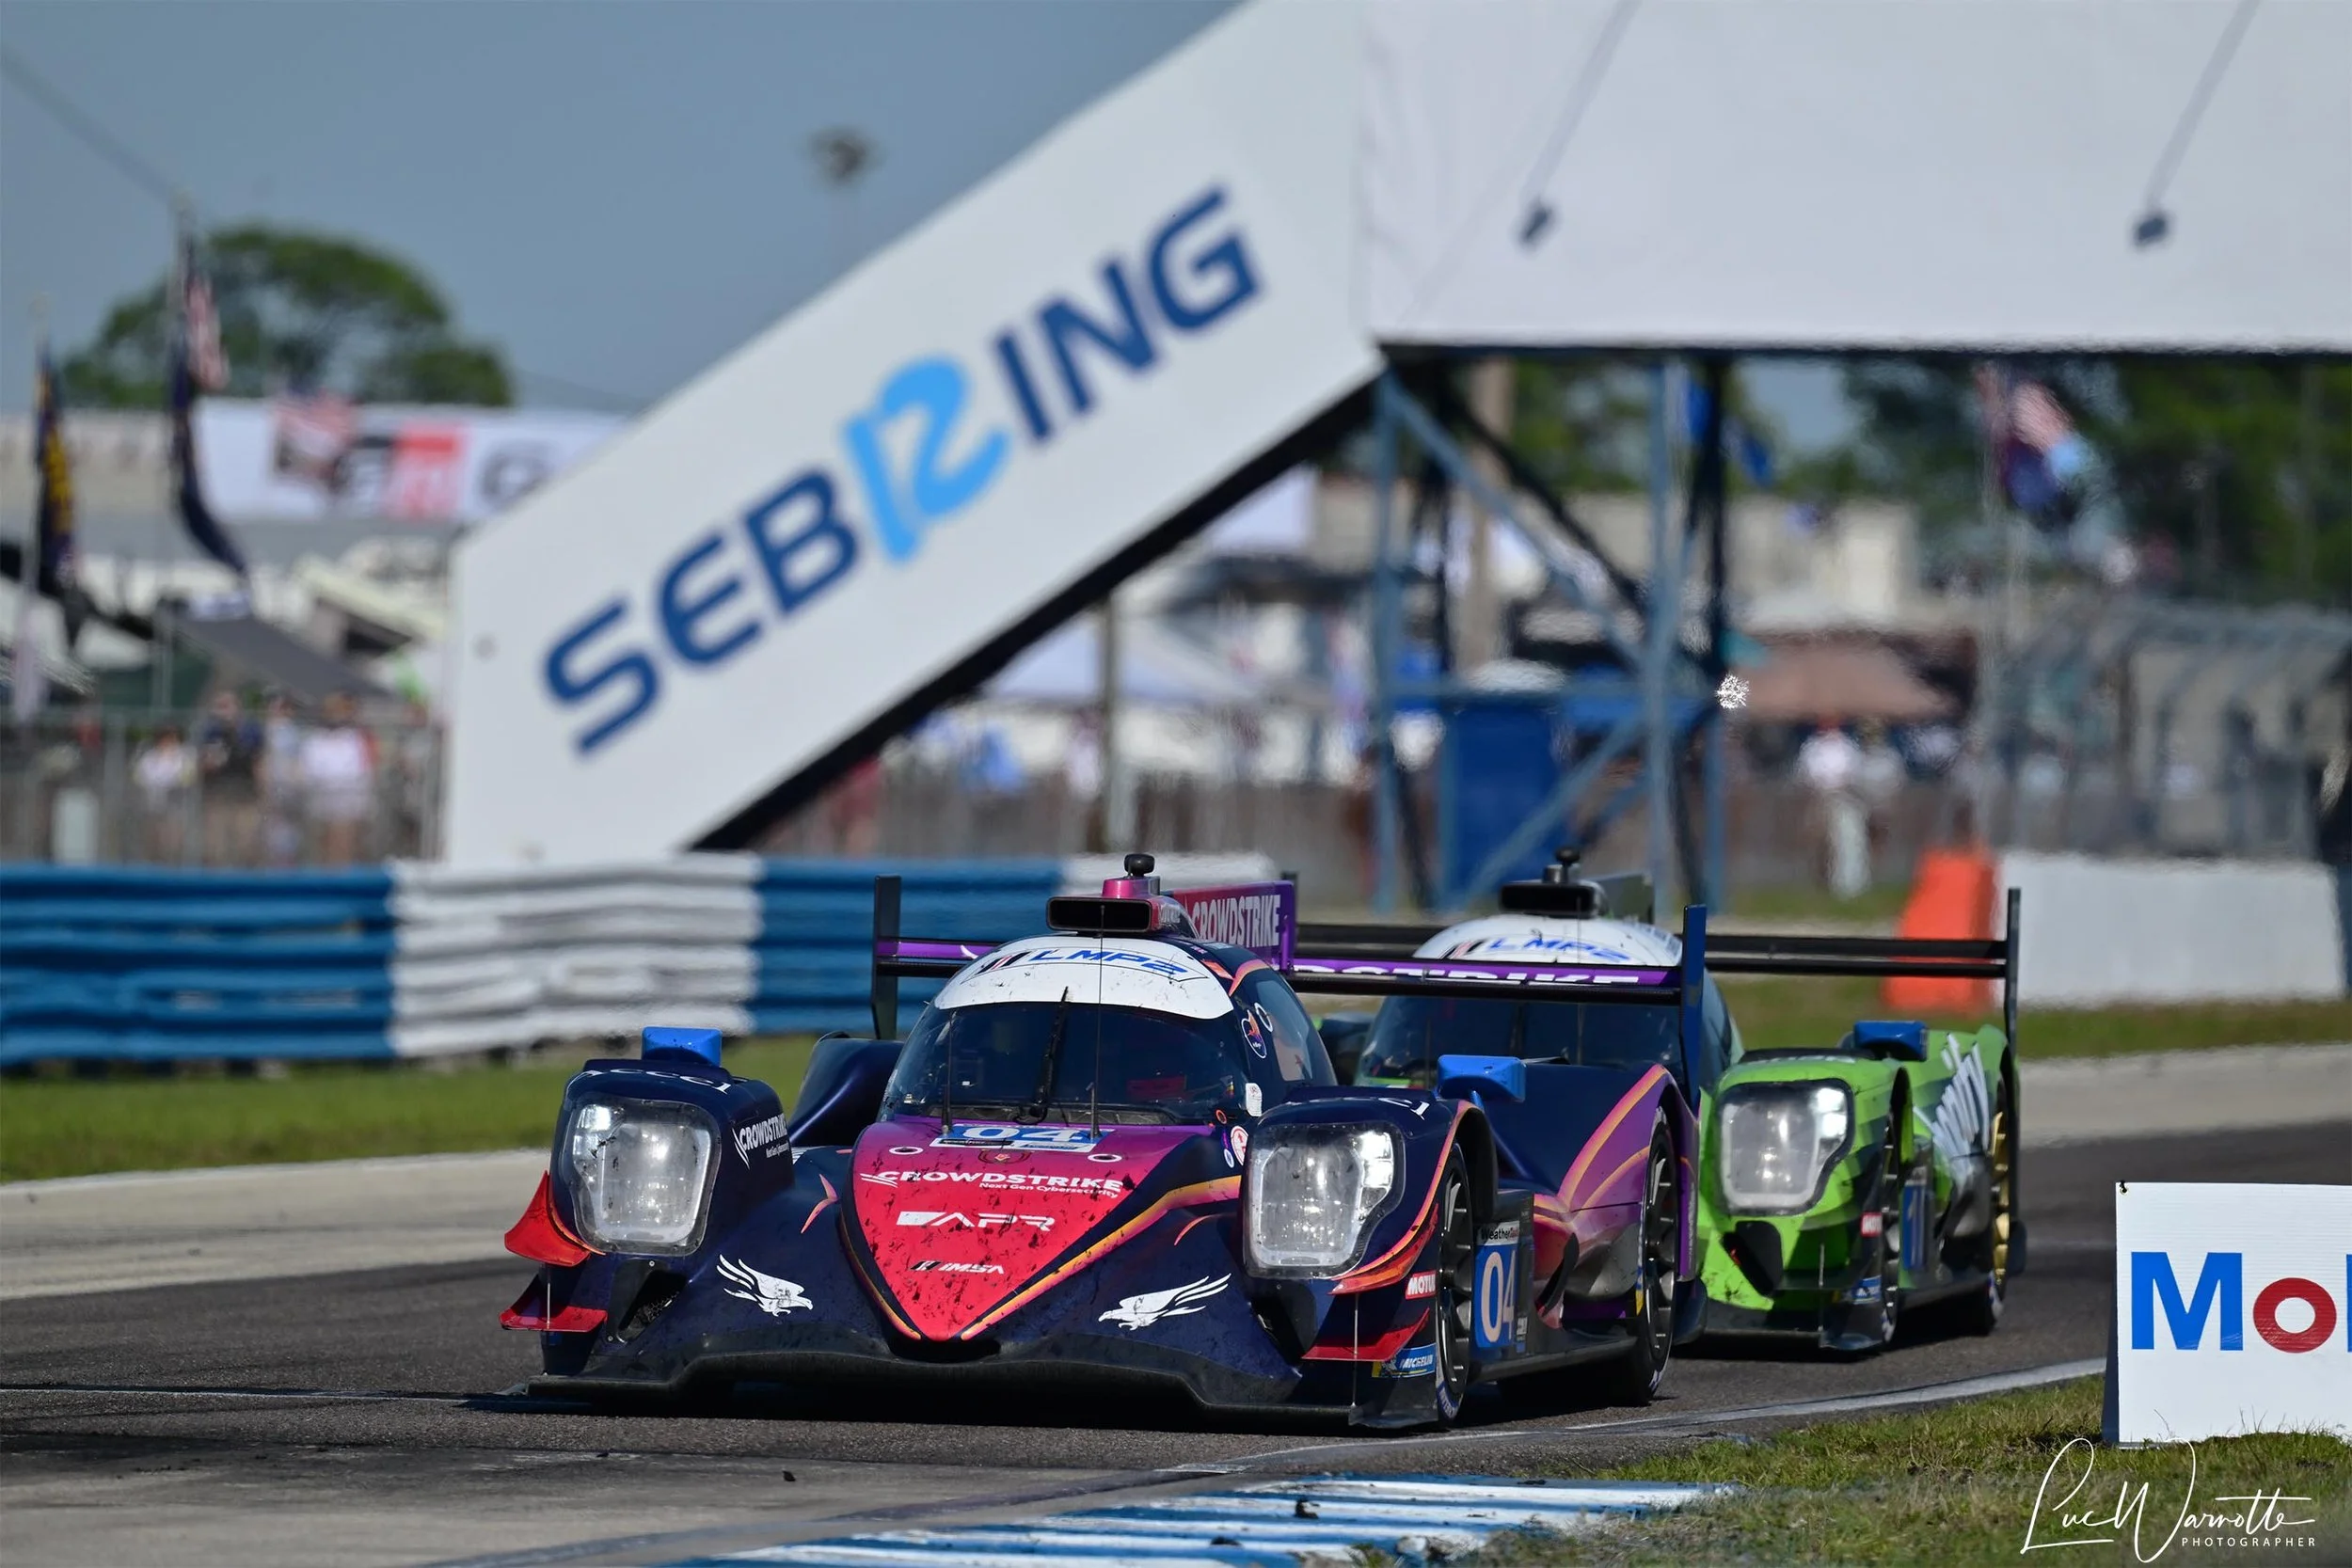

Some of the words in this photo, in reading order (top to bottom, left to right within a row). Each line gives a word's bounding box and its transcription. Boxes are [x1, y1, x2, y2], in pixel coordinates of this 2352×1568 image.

[539, 183, 1264, 756] SEBRING
[1030, 949, 1188, 975] LMP2
[961, 1127, 1084, 1142] 04
[877, 1171, 1124, 1193] CROWDSTRIKE
[939, 1261, 1005, 1275] IMSA
[1481, 1250, 1516, 1343] 04
[2131, 1251, 2352, 1354] Mo
